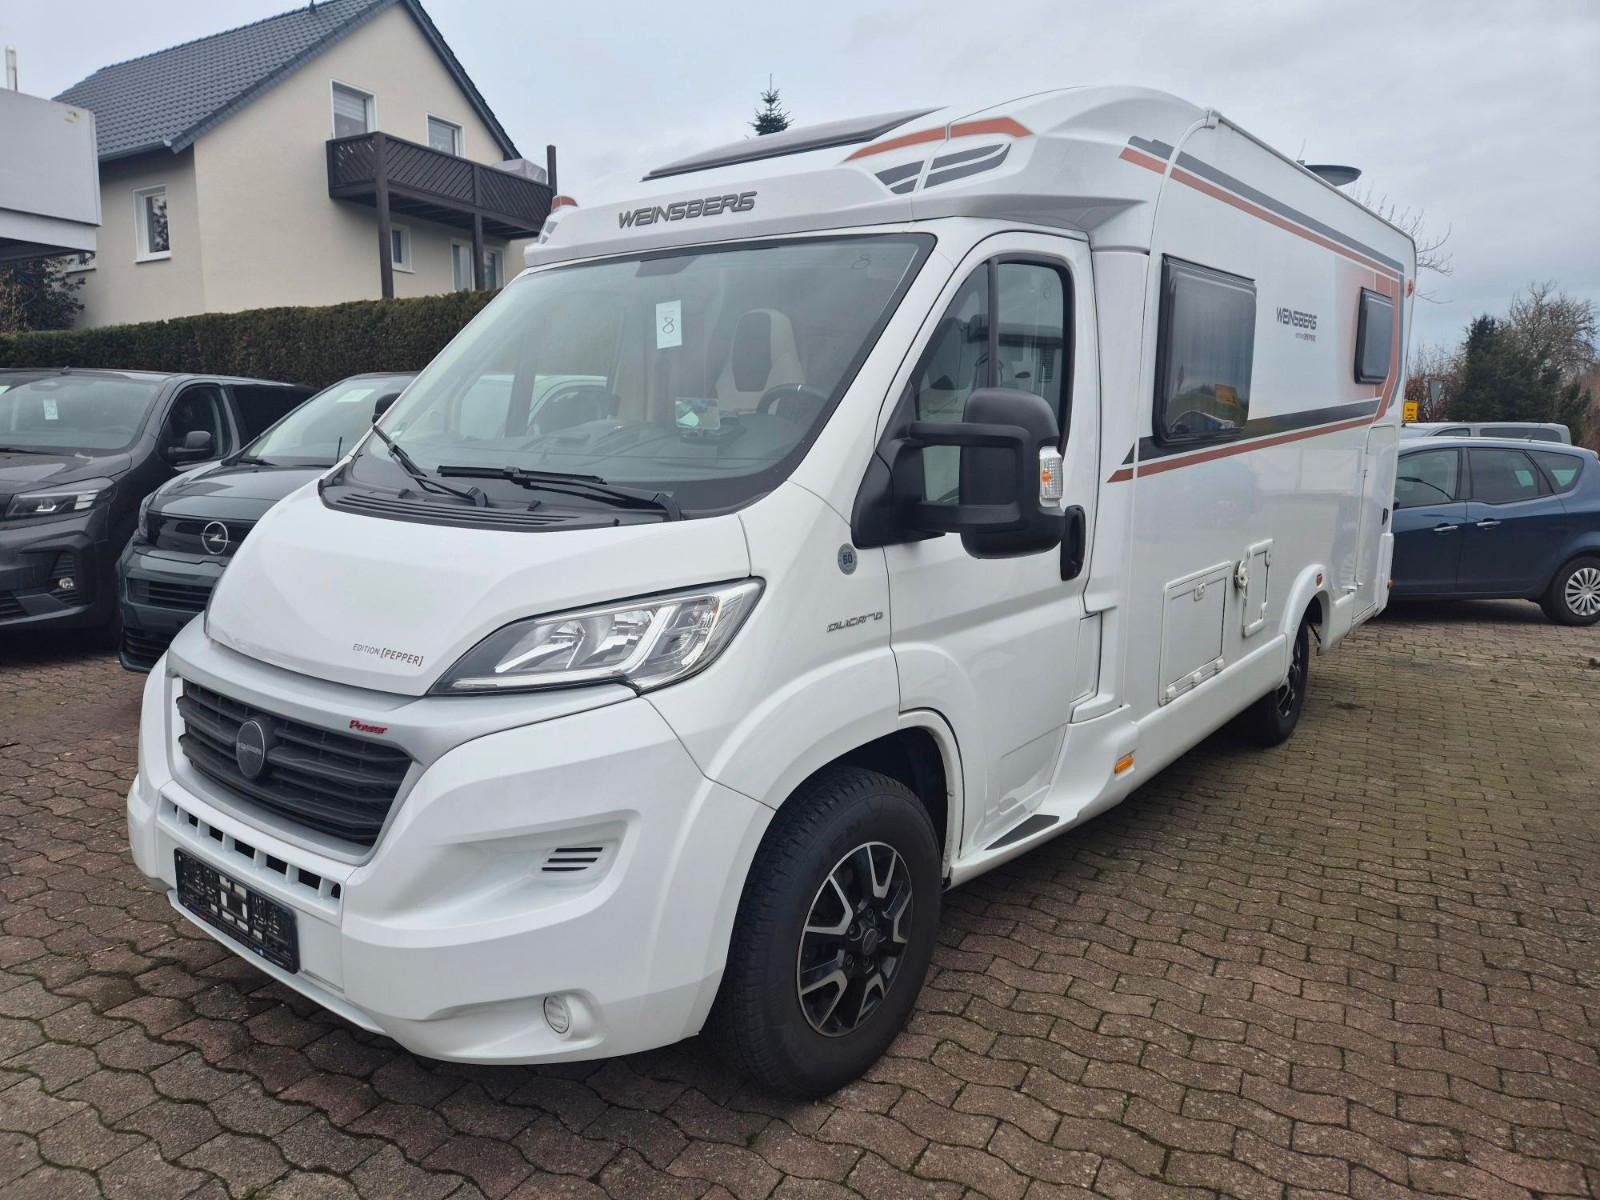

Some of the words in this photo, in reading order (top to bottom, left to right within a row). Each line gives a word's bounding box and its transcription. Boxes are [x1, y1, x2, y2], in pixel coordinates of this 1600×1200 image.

[618, 190, 757, 229] WEINSBERG
[662, 316, 675, 335] 8
[352, 643, 380, 656] EDITION
[380, 647, 424, 667] [PEPPER]
